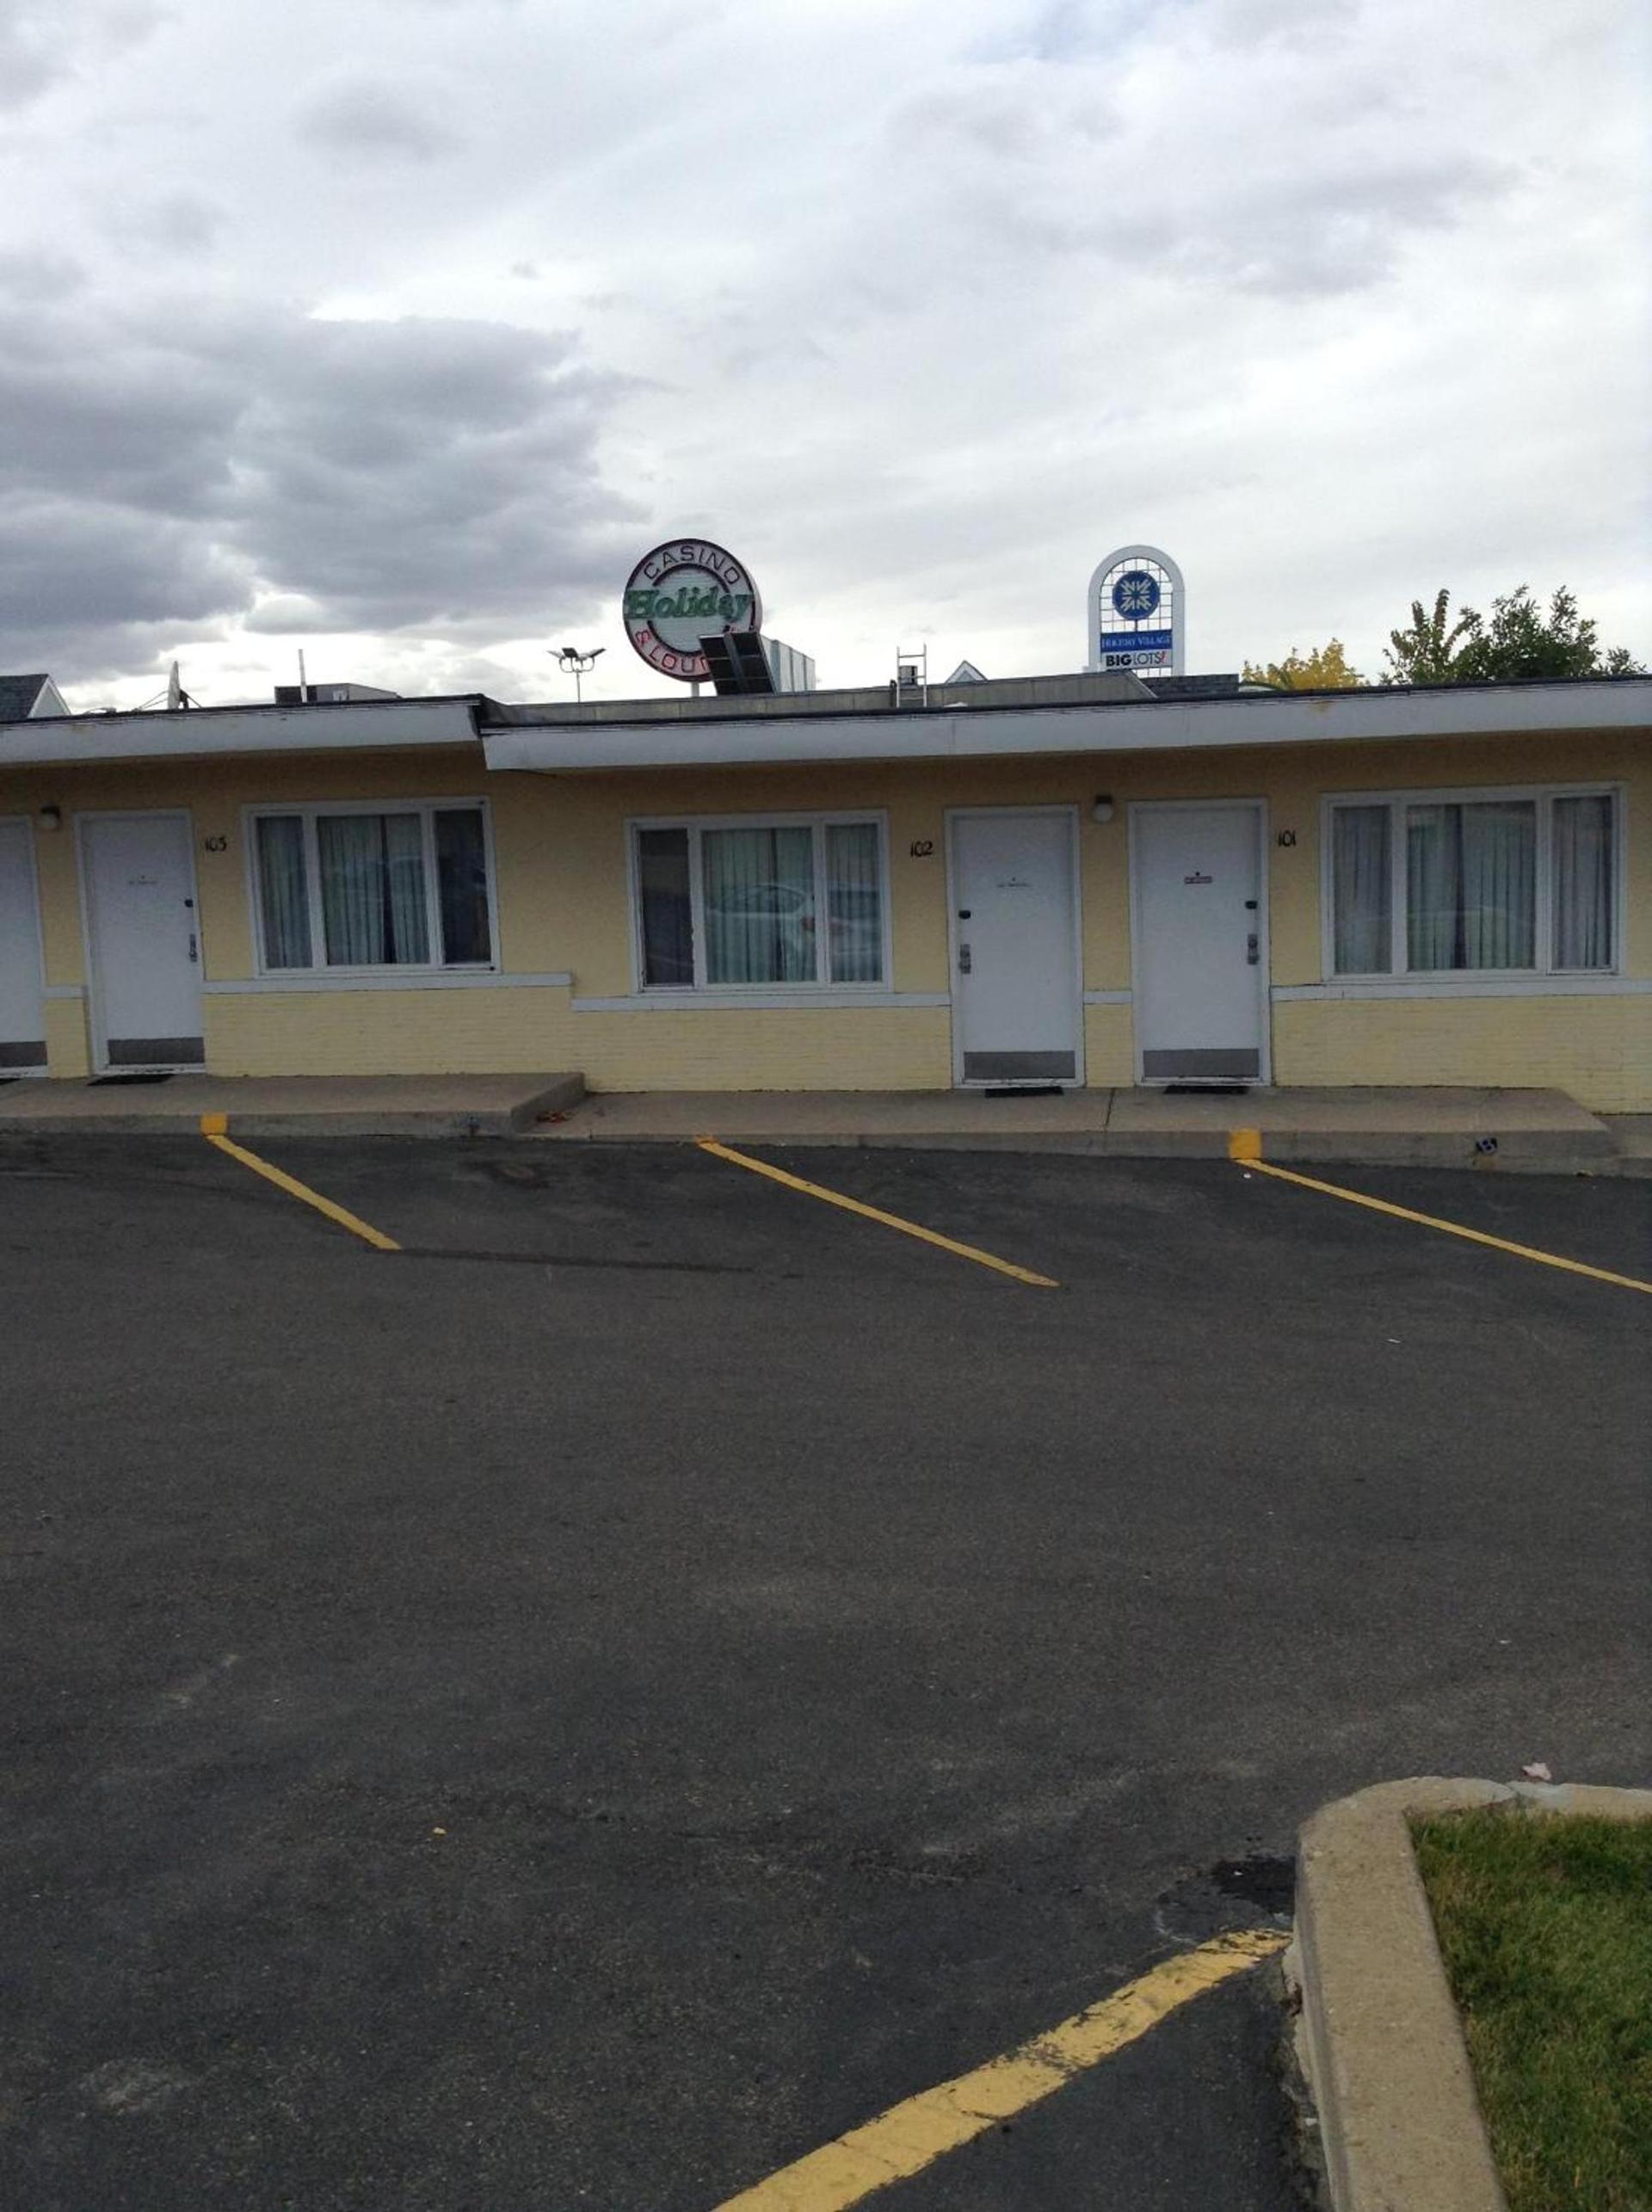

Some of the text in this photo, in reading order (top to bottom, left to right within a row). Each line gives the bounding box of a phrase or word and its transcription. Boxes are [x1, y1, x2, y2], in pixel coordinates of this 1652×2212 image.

[644, 545, 740, 585] CASINO
[1106, 654, 1132, 667] BIG
[1279, 829, 1296, 847] 101
[910, 841, 933, 857] 102
